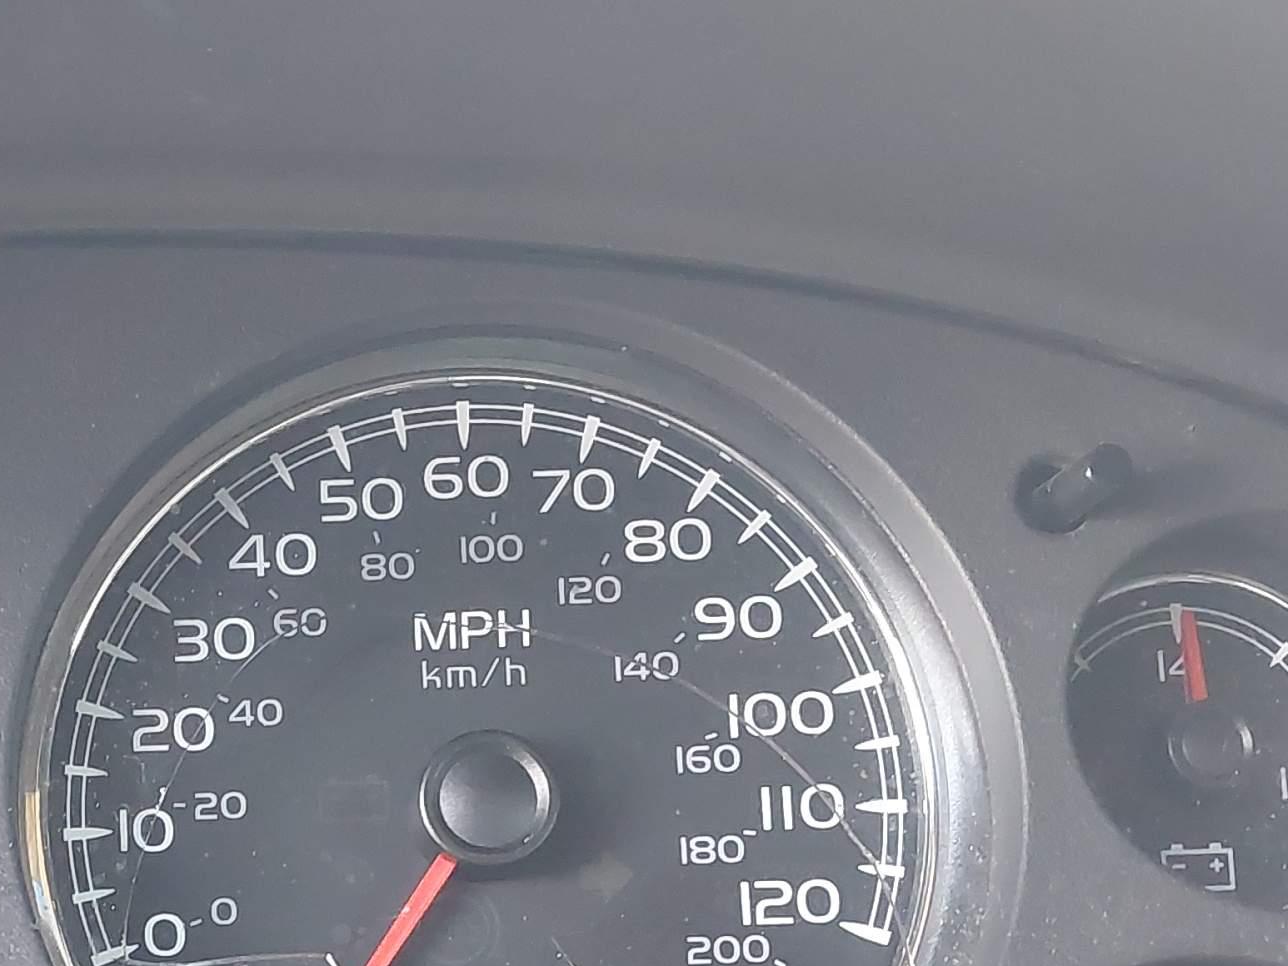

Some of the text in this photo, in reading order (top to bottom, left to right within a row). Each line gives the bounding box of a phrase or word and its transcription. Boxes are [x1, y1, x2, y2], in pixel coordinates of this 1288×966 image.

[423, 455, 509, 500] 60
[531, 468, 615, 513] 70
[319, 477, 404, 523] 50
[228, 533, 316, 577] 40
[460, 534, 523, 563] 100
[624, 518, 711, 563] 80
[360, 552, 414, 582] 80
[558, 575, 622, 604] 120
[173, 617, 255, 662] 30
[273, 607, 327, 637] 60
[413, 609, 530, 651] MPH
[694, 595, 783, 641] 90
[421, 657, 527, 689] km/h
[614, 651, 679, 682] 140
[132, 707, 214, 752] 20
[228, 699, 283, 727] 40
[728, 690, 834, 738] 100
[675, 744, 740, 774] 160
[194, 791, 247, 820] 20
[760, 783, 844, 831] 110
[118, 808, 175, 853] 10
[679, 834, 745, 864] 180
[211, 897, 238, 925] 0
[740, 879, 840, 926] 120
[144, 913, 185, 957] 0
[686, 935, 770, 965] 200
